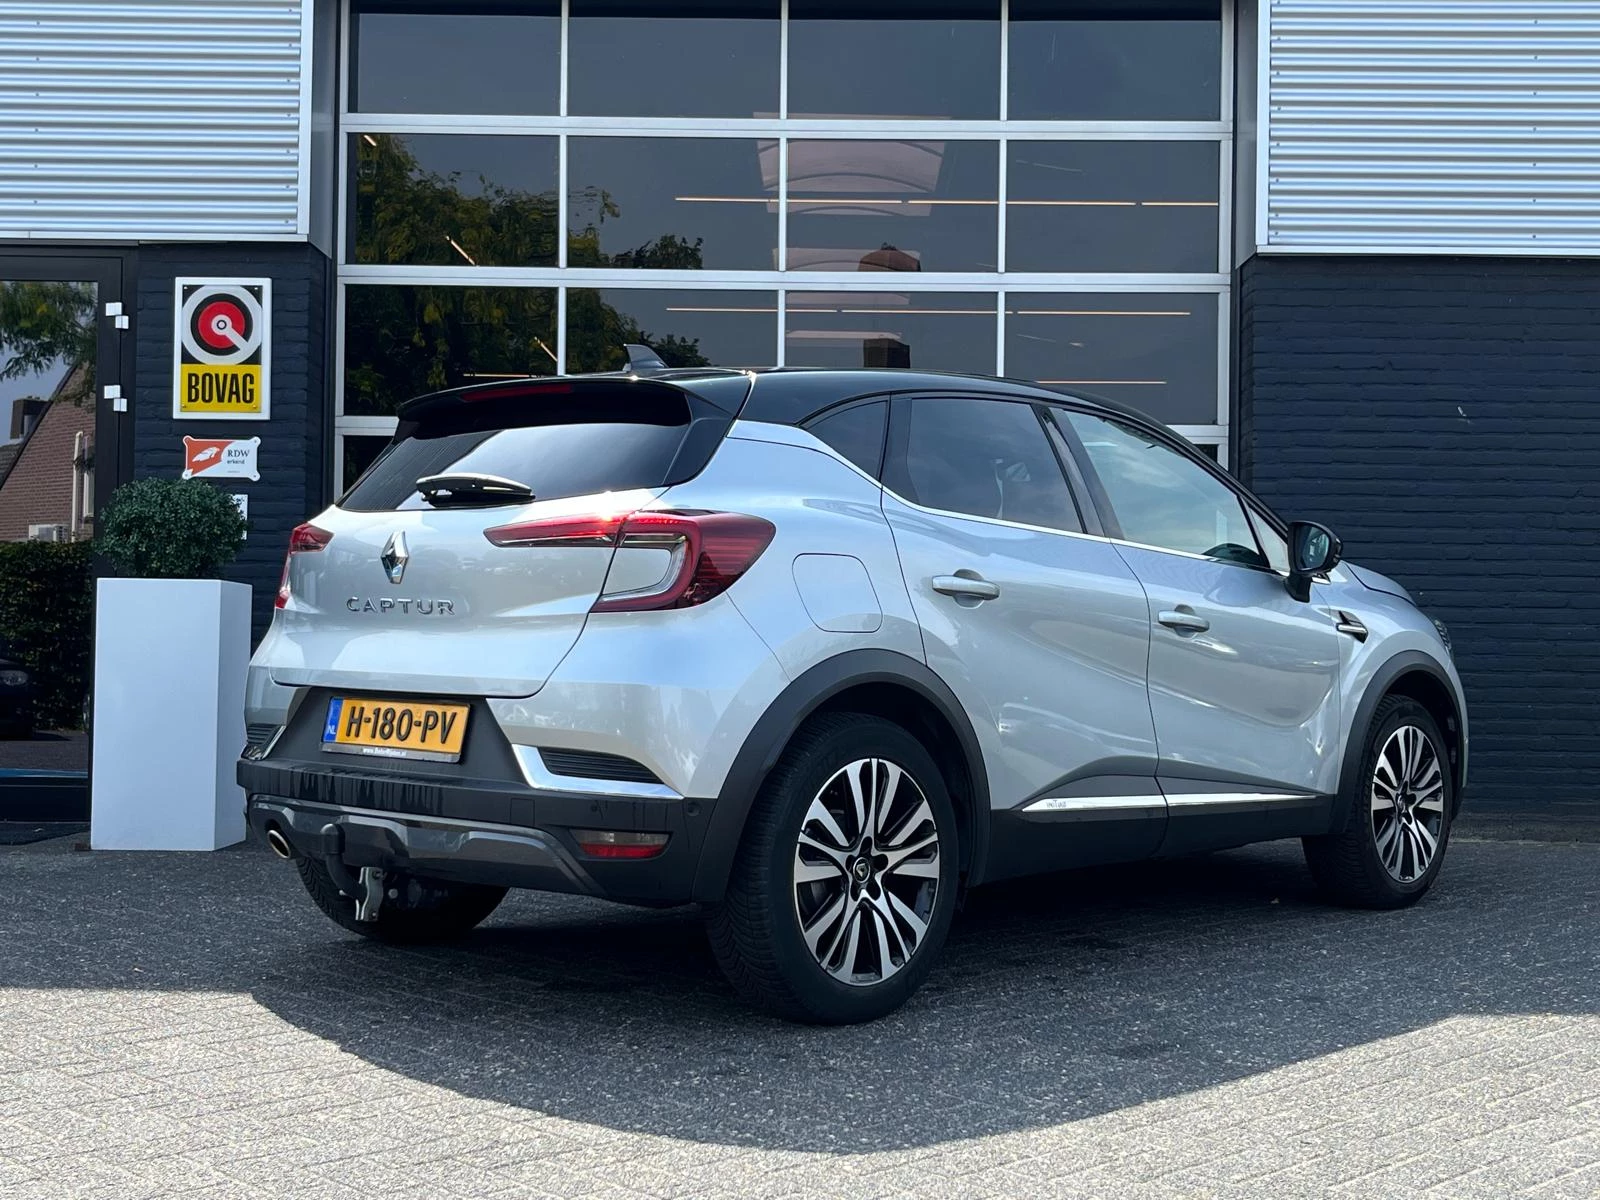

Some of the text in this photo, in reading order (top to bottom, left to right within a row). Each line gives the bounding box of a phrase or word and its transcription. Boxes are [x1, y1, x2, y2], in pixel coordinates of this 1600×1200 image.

[187, 372, 255, 404] BOVAG
[227, 449, 250, 458] RDW
[346, 596, 455, 616] CAPTUR
[327, 724, 336, 735] NL
[345, 705, 458, 745] H-180-PV
